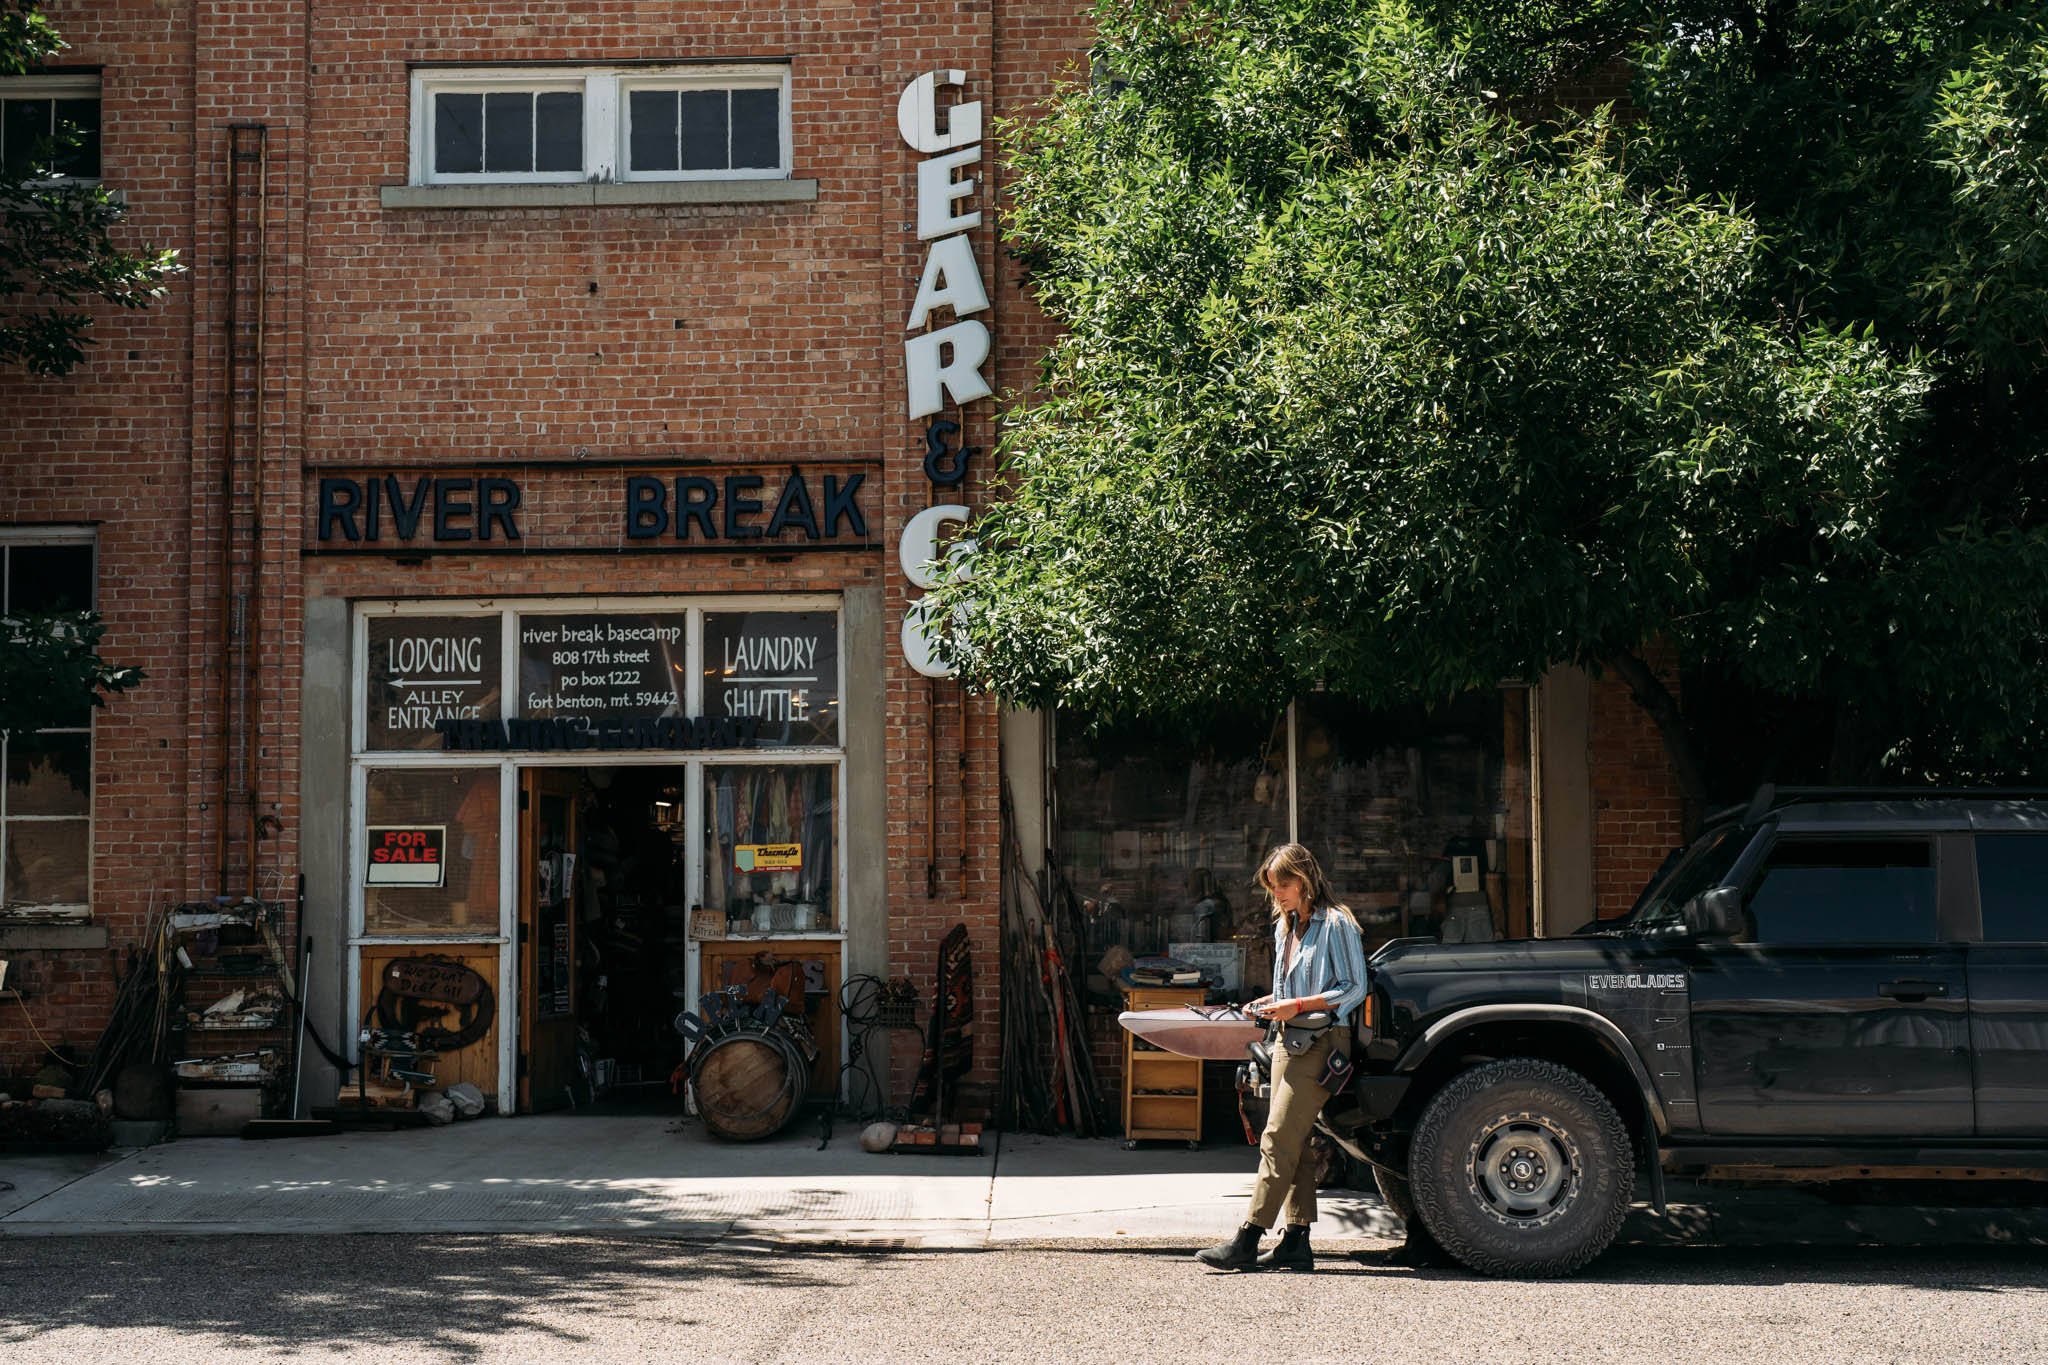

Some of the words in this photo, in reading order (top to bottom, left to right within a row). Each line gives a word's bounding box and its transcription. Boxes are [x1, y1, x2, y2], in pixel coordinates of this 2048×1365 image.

[897, 68, 993, 421] GEAR
[924, 420, 981, 487] &
[317, 474, 521, 541] RIVER
[626, 472, 867, 541] BREAK
[522, 629, 557, 643] river
[562, 624, 604, 643] break
[608, 623, 681, 645] basecamp
[389, 637, 481, 673] LODGING
[552, 651, 579, 665] 808
[582, 648, 610, 664] 17th
[613, 649, 650, 663] street
[725, 636, 817, 671] LAUNDRY
[561, 675, 578, 691] po
[581, 671, 606, 686] box
[608, 671, 641, 686] 1222
[404, 690, 464, 704] ALLEY
[528, 692, 553, 709] fort
[556, 693, 607, 709] benton,
[610, 694, 632, 707] mt.
[636, 692, 678, 705] 59442
[724, 688, 808, 722] SHUTTLE
[384, 831, 427, 847] FOR
[373, 848, 438, 863] SALE
[1589, 974, 1685, 989] EVERGLADES
